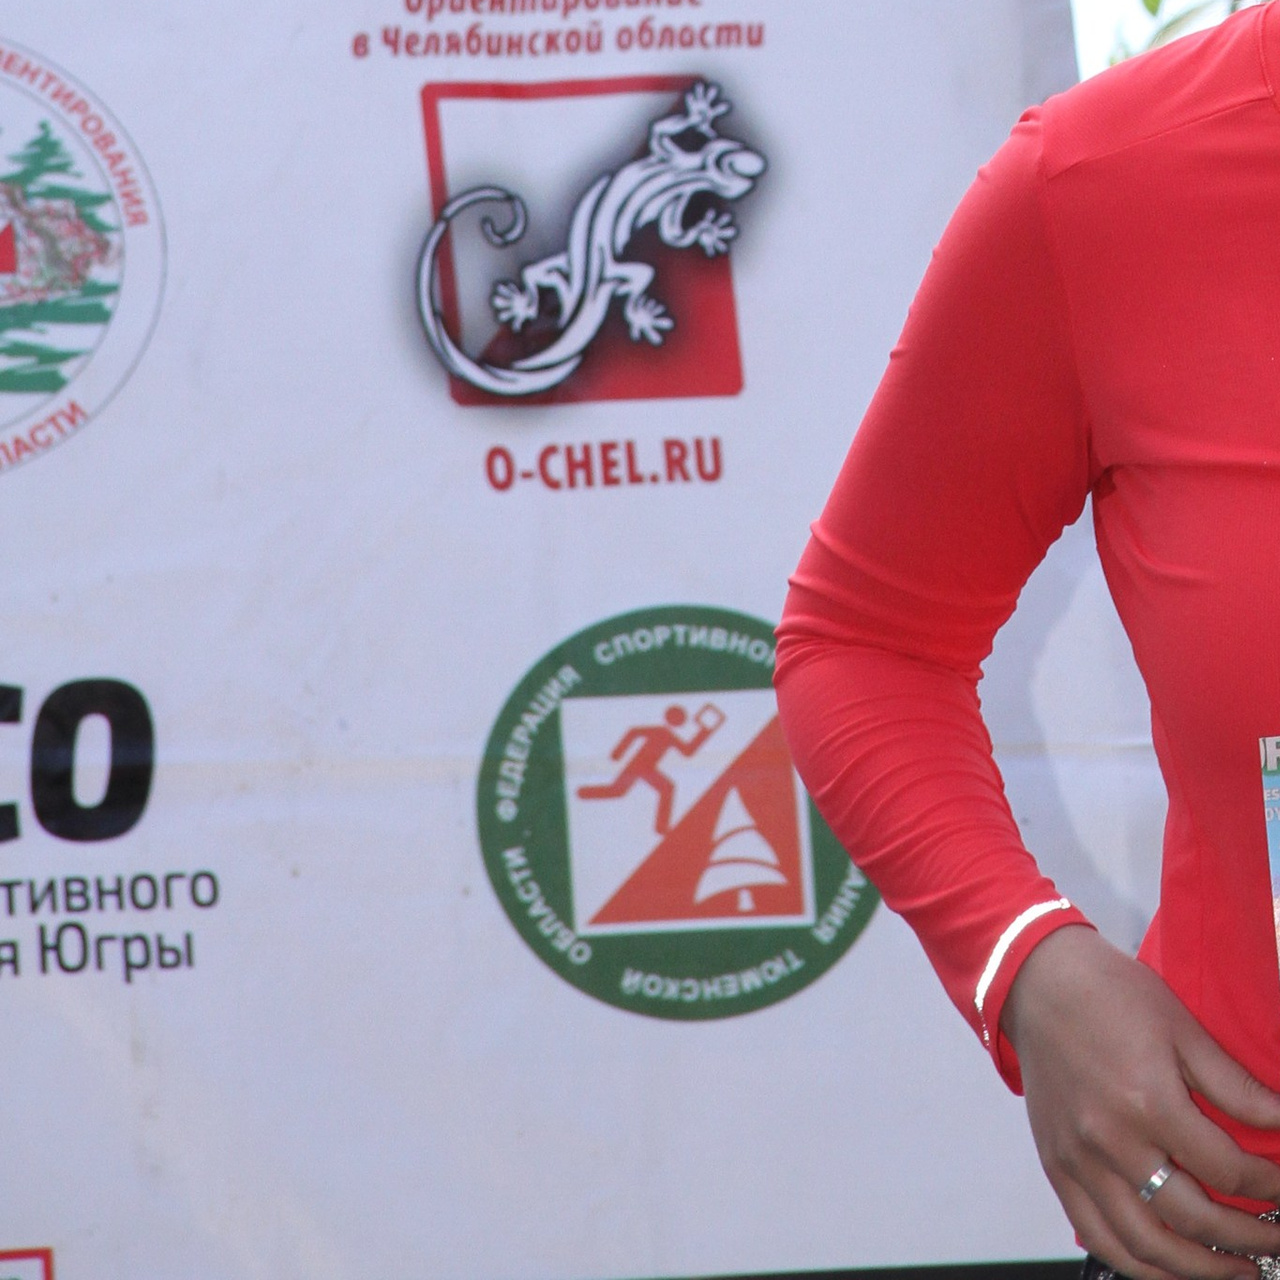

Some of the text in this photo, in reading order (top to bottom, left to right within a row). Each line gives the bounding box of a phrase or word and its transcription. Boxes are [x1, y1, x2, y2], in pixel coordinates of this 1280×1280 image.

[352, 15, 766, 58] в Челябинской области
[0, 48, 149, 228] ЕНТИРОВАНИЯ
[485, 436, 723, 492] O-CHEL.RU
[495, 664, 583, 823] ФЕДЕРАЦИЯ
[593, 623, 776, 668] СПОРТИВНО
[38, 921, 194, 985] Югры
[502, 846, 805, 1002] ТЮМЕНСКОЙ ОБЛАСТИ
